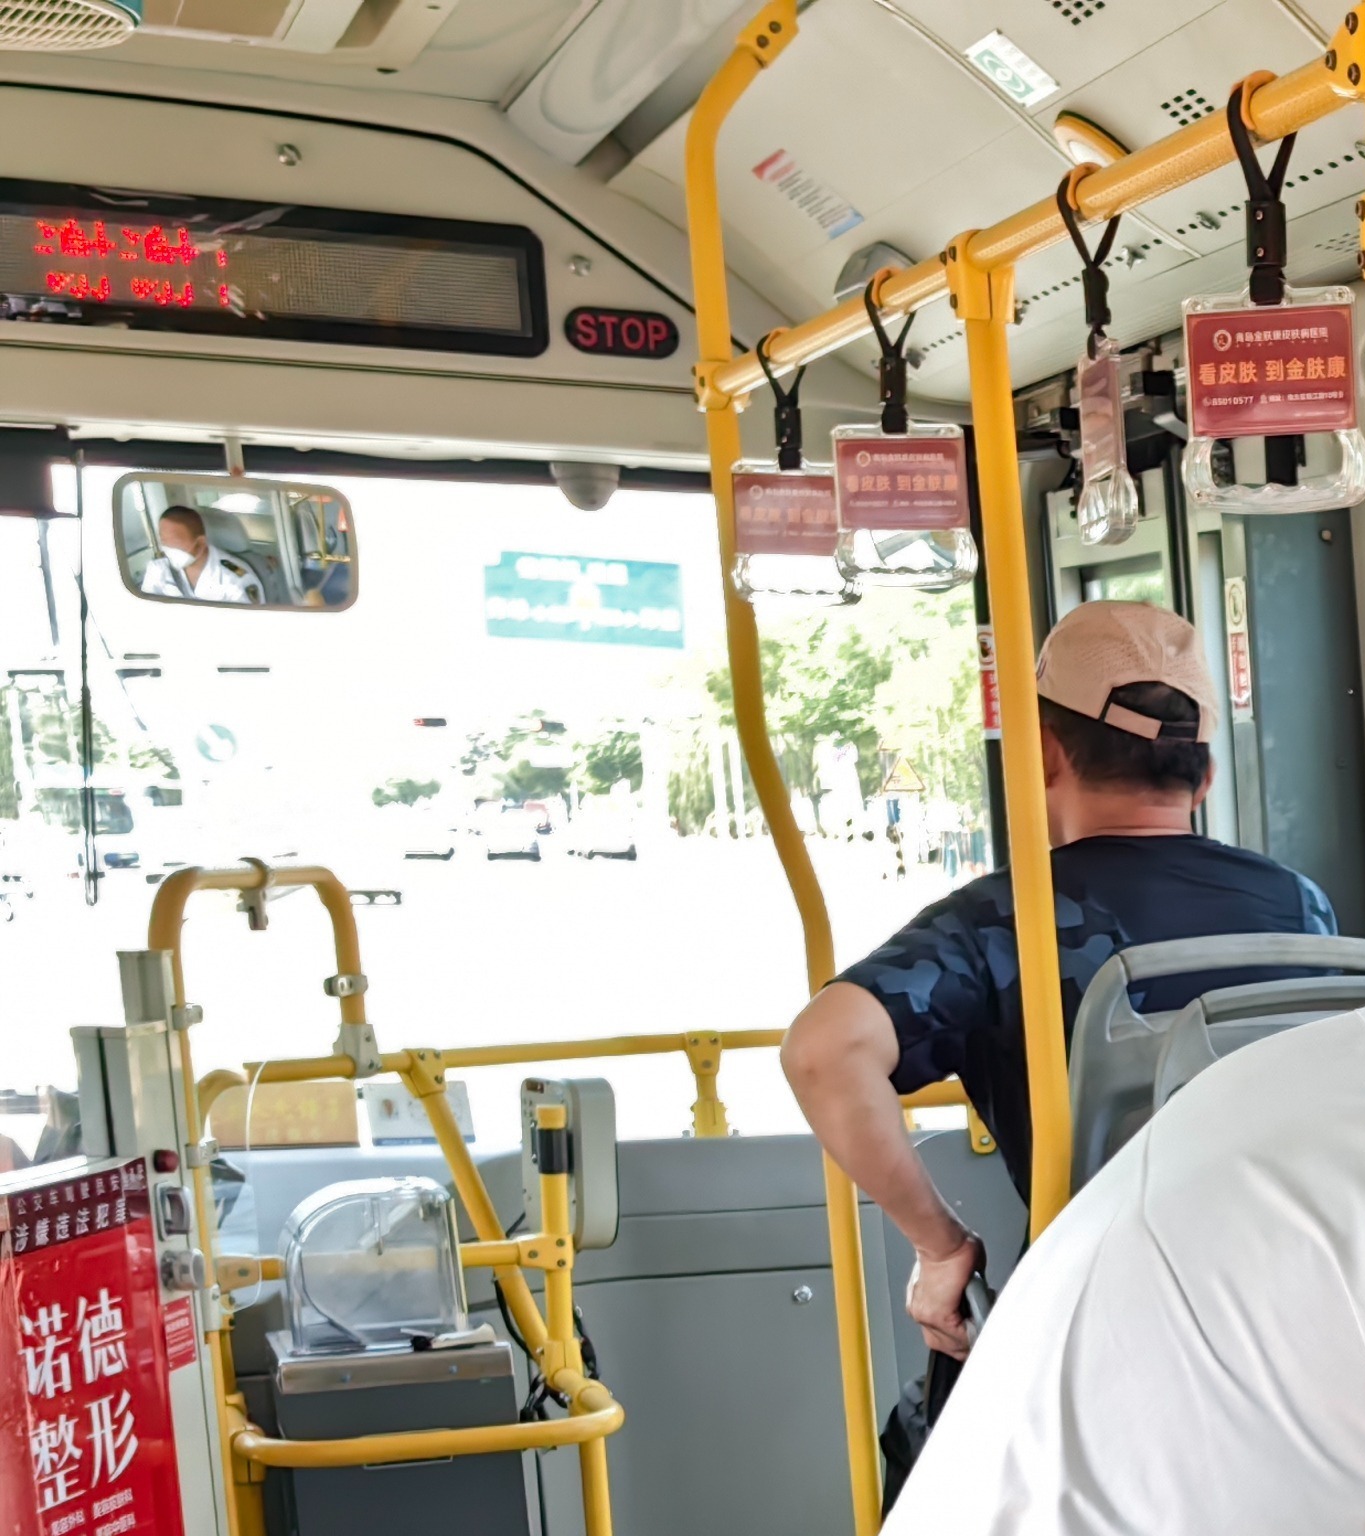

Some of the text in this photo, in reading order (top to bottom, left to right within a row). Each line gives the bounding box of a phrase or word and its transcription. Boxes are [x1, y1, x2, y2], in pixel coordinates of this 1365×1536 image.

[575, 313, 670, 351] STOP
[1199, 355, 1346, 386] 看皮肤 到金肤康
[1212, 396, 1255, 406] 85010577
[18, 1288, 129, 1399] 诺德
[31, 1389, 139, 1514] 整形
